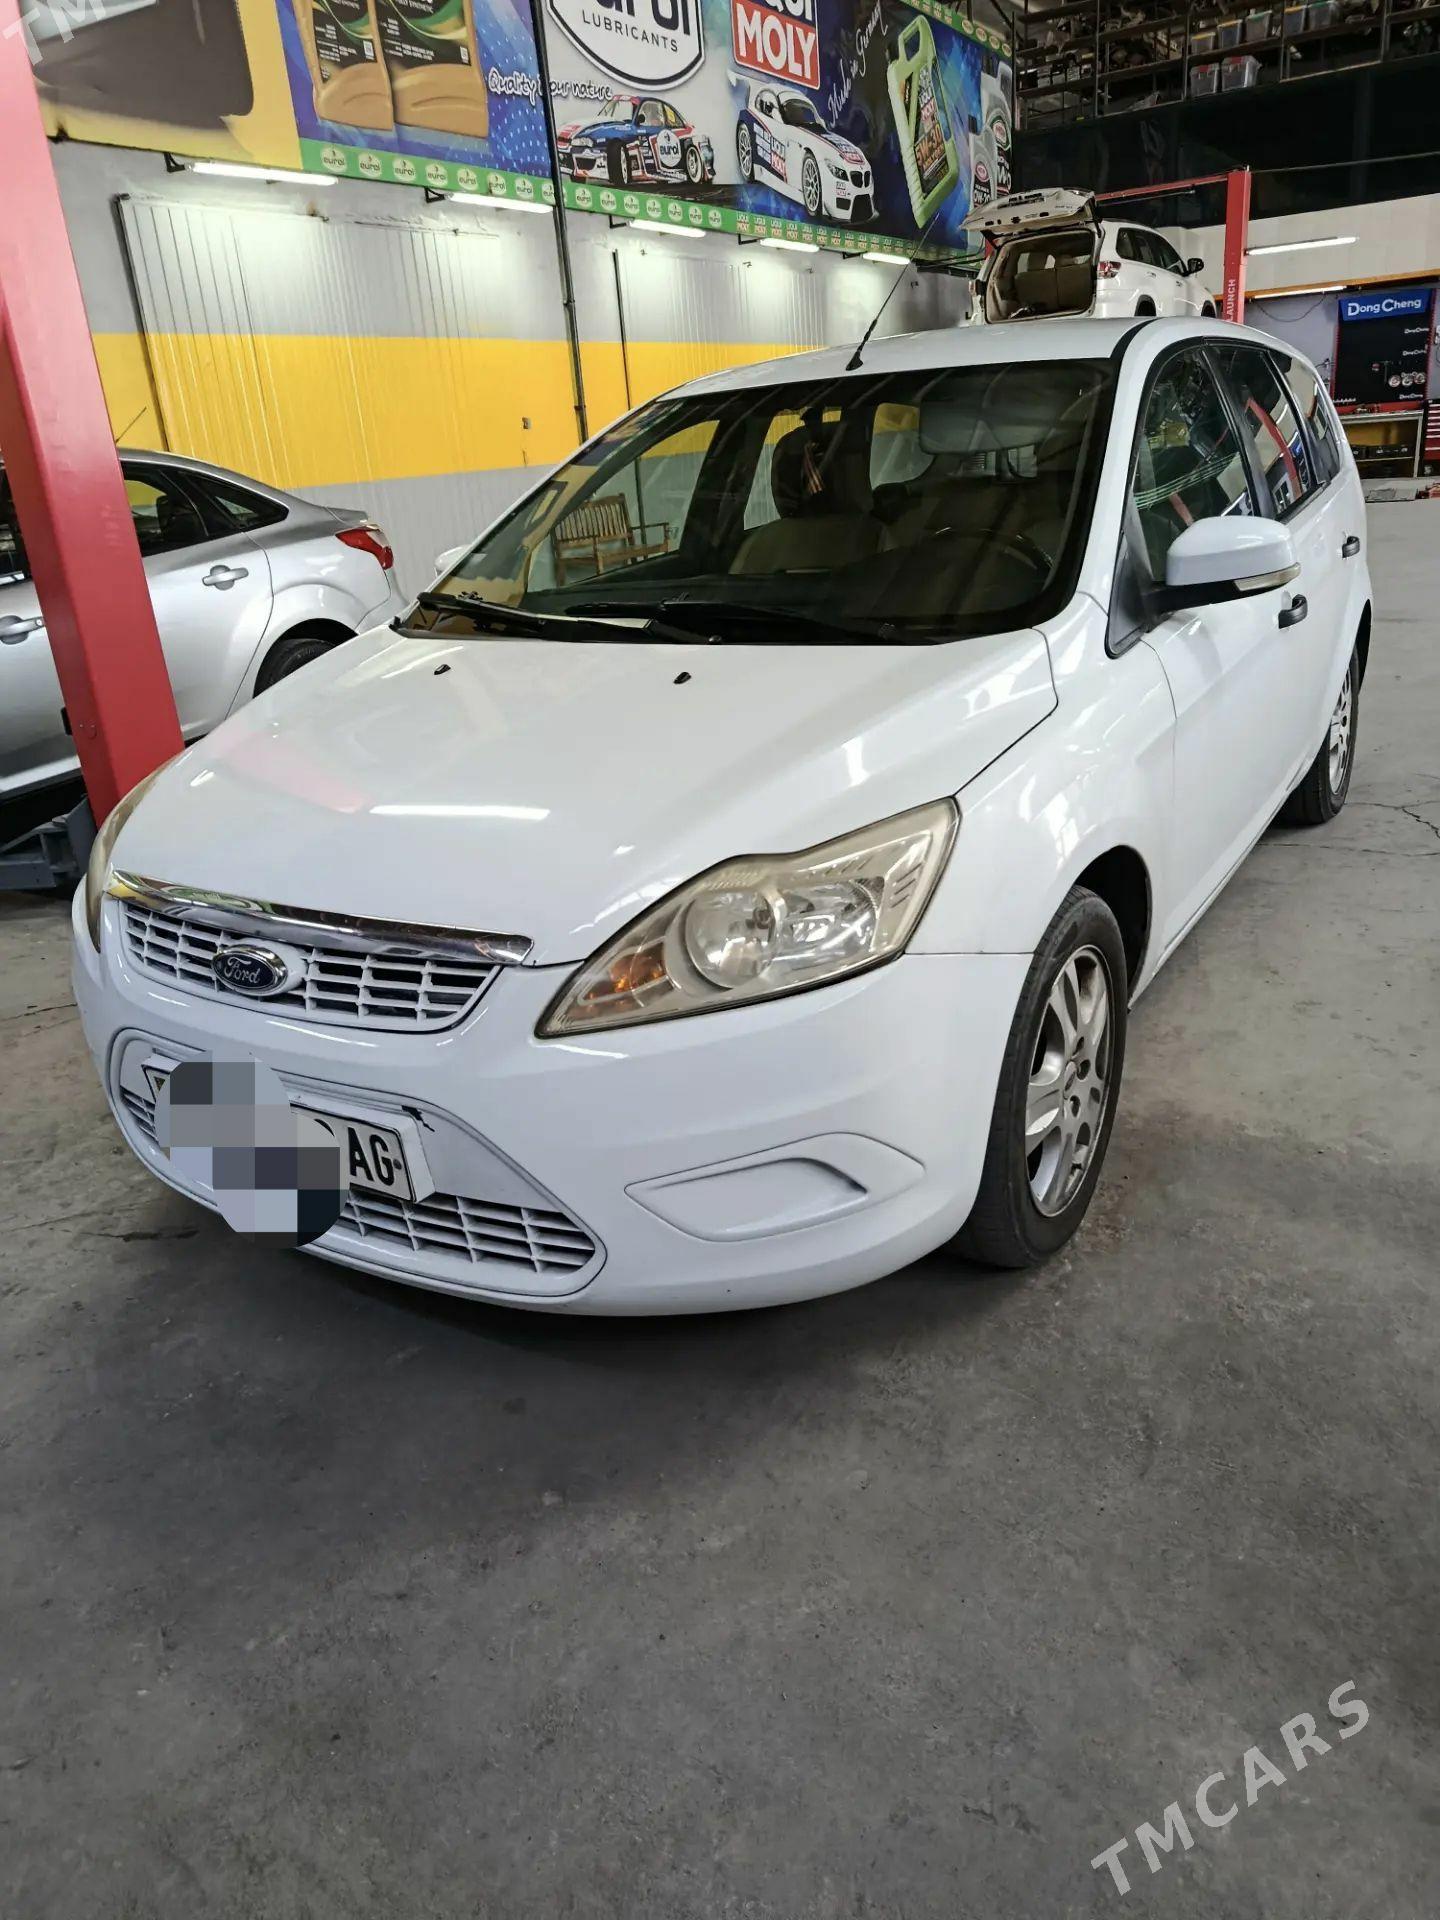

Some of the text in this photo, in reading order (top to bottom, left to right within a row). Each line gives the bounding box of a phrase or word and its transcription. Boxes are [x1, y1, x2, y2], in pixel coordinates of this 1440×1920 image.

[582, 10, 678, 52] LUBRICANTS
[736, 3, 815, 79] MOLY
[488, 67, 536, 106] Quality
[571, 80, 613, 99] nature
[660, 141, 679, 156] eurol
[1226, 279, 1236, 321] LAUNCH
[224, 957, 261, 984] Ford
[347, 1127, 395, 1186] AG
